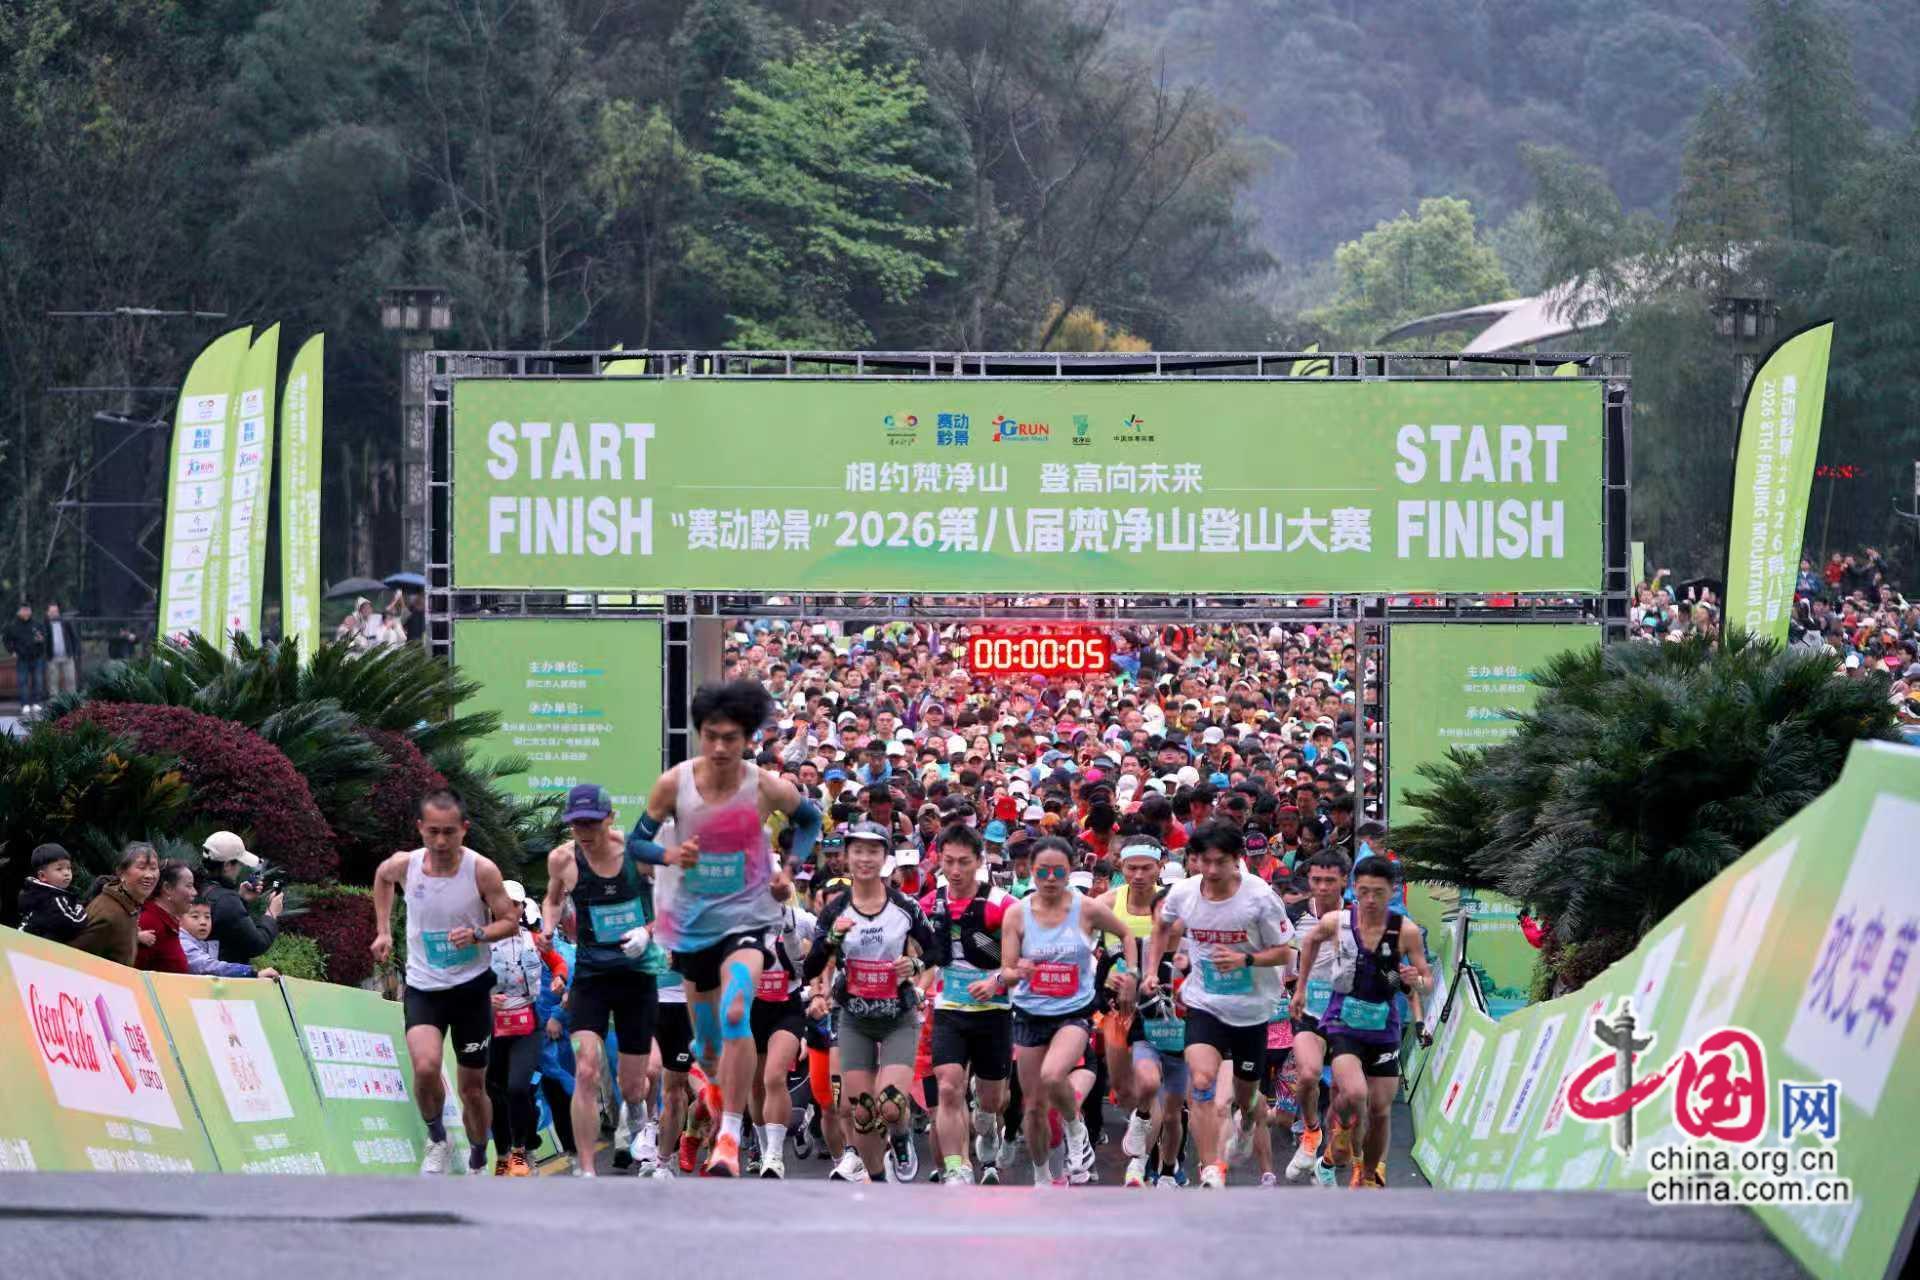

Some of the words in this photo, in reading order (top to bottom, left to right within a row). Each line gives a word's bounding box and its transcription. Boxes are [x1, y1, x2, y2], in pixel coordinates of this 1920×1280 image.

[487, 421, 656, 480] START
[937, 414, 968, 429] 赛动
[845, 462, 1008, 493] 相约梵净山
[1039, 463, 1203, 494] 登高向未来
[1396, 424, 1567, 484] START
[489, 495, 653, 556] FINISH
[1397, 499, 1564, 560] FINISH
[974, 638, 1105, 669] 00:00:05
